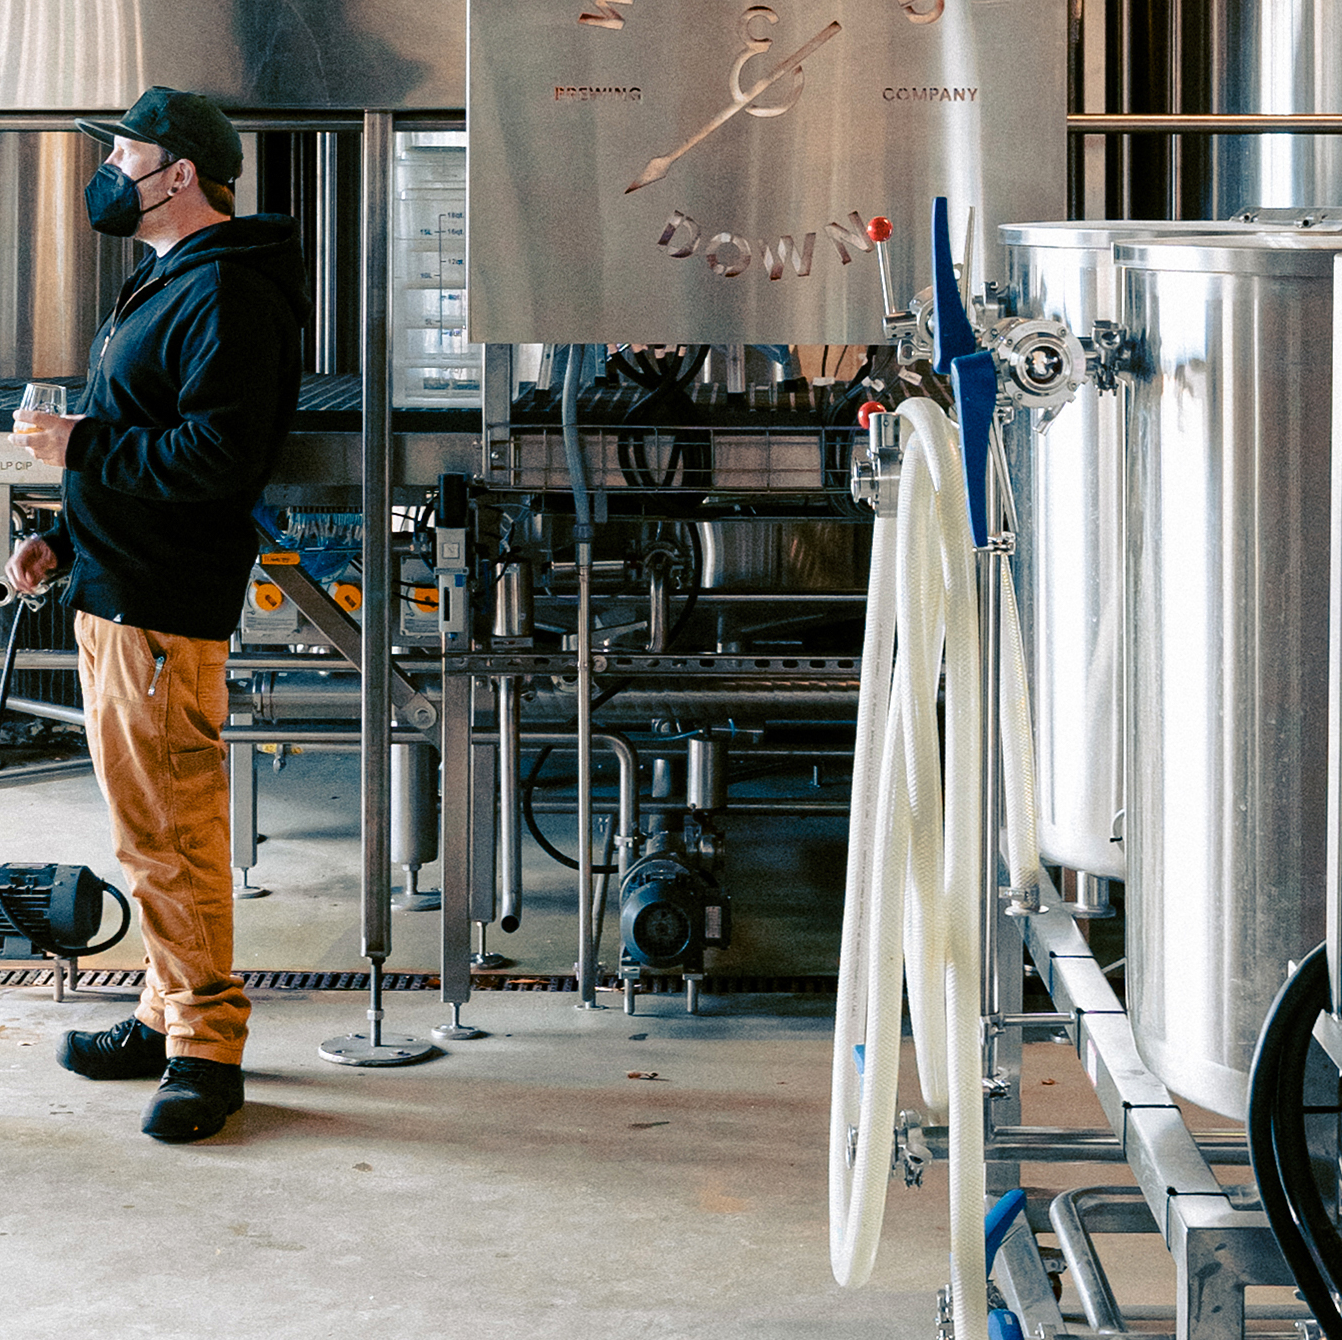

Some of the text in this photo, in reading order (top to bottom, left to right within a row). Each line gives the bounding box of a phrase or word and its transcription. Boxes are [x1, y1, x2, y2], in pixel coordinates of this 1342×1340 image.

[554, 86, 642, 101] BREWING
[882, 87, 979, 102] COMPANY
[658, 210, 875, 281] DOWN
[0, 461, 14, 471] LP
[15, 461, 33, 471] CIP
